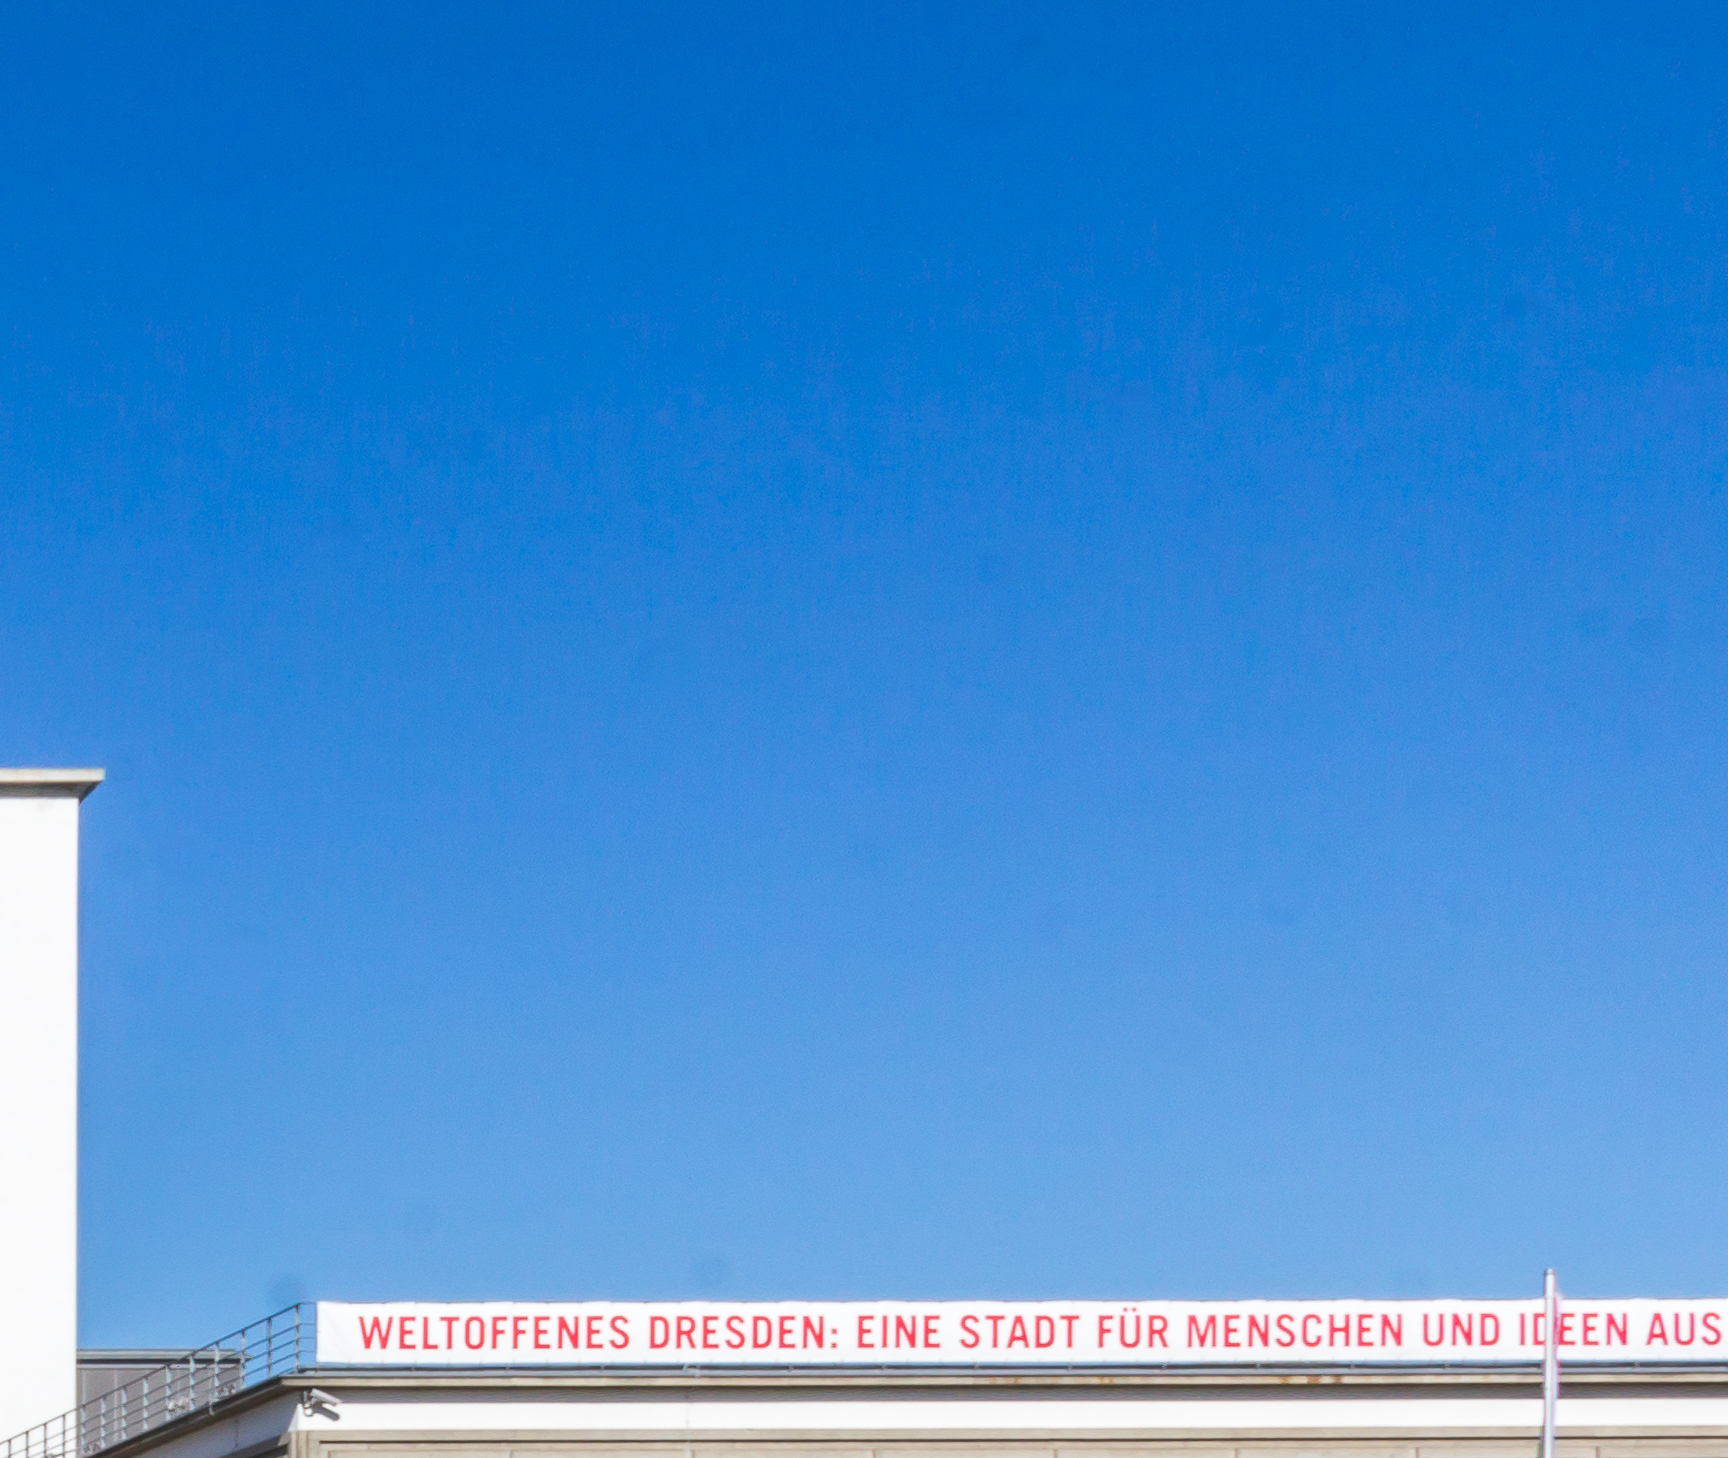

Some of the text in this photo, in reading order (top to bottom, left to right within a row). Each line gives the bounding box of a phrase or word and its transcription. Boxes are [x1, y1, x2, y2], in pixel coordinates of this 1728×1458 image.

[359, 1316, 629, 1350] WELTOFFENES
[650, 1316, 837, 1349] DRESDEN:
[858, 1315, 940, 1348] EINE
[961, 1315, 1080, 1348] STADT
[1098, 1308, 1168, 1348] FÜR
[1188, 1314, 1402, 1347] MENSCHEN
[1423, 1313, 1499, 1346] UND
[1647, 1312, 1721, 1345] AUS
